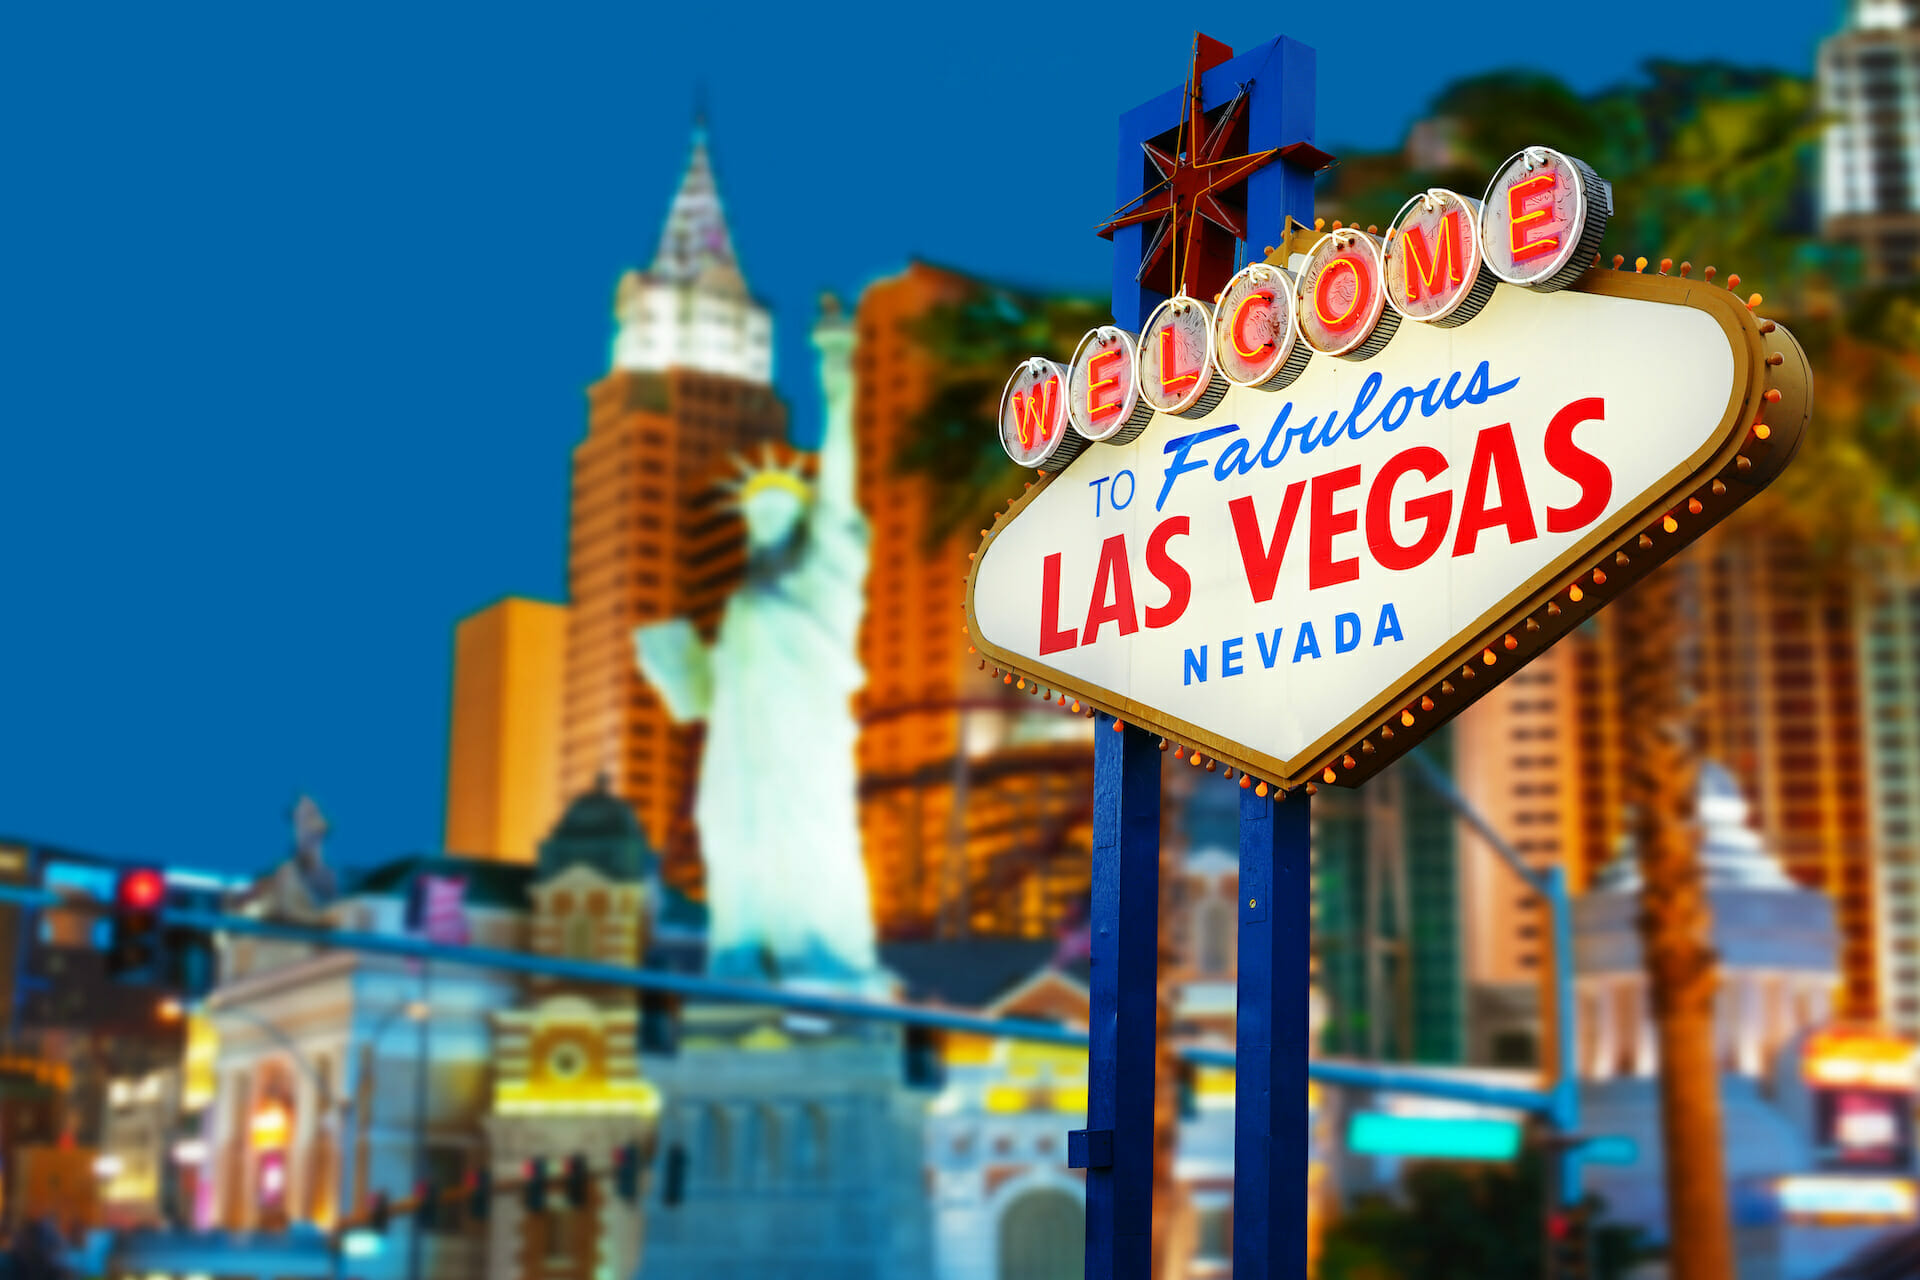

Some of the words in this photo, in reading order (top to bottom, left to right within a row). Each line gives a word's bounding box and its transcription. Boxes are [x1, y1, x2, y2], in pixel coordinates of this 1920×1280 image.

[1010, 171, 1561, 452] WELCOME
[1039, 515, 1192, 656] LAS
[1227, 396, 1614, 604] VEGAS
[1088, 471, 1136, 518] TO
[1155, 359, 1521, 513] Fabulous
[1183, 602, 1405, 687] NEVADA
